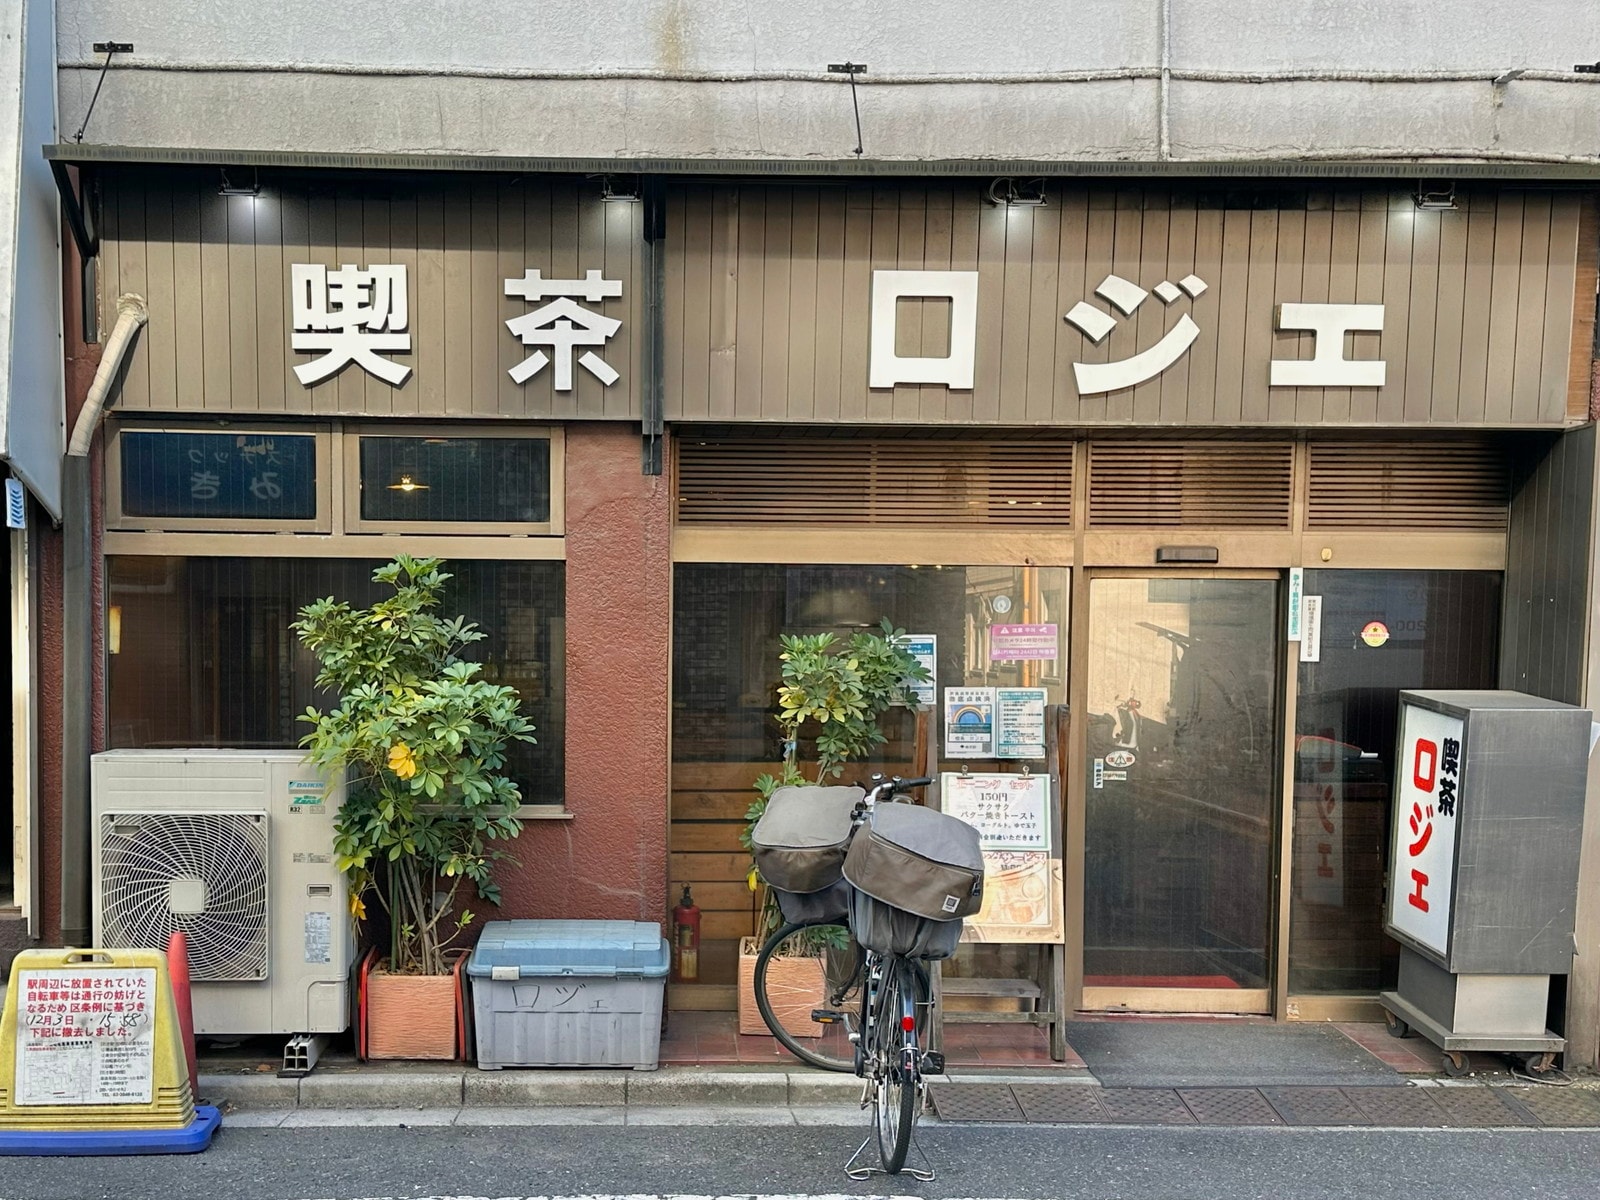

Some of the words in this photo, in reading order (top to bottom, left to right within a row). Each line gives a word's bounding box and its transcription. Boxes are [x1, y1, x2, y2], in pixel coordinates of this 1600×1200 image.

[291, 263, 623, 391] 喫茶
[869, 269, 1386, 395] ロジェ
[1437, 737, 1460, 818] 喫茶
[956, 779, 1002, 790] モーニング
[979, 792, 1008, 802] 150円
[977, 803, 1010, 811] サクサク
[960, 812, 1035, 820] バター焼きトースト
[1408, 737, 1438, 914] ロジェ
[27, 978, 147, 989] 駅周辺に放置されていた
[27, 991, 146, 1001] 自転車等は通行の妨げと
[29, 1027, 132, 1038] 下記に撤去しました。
